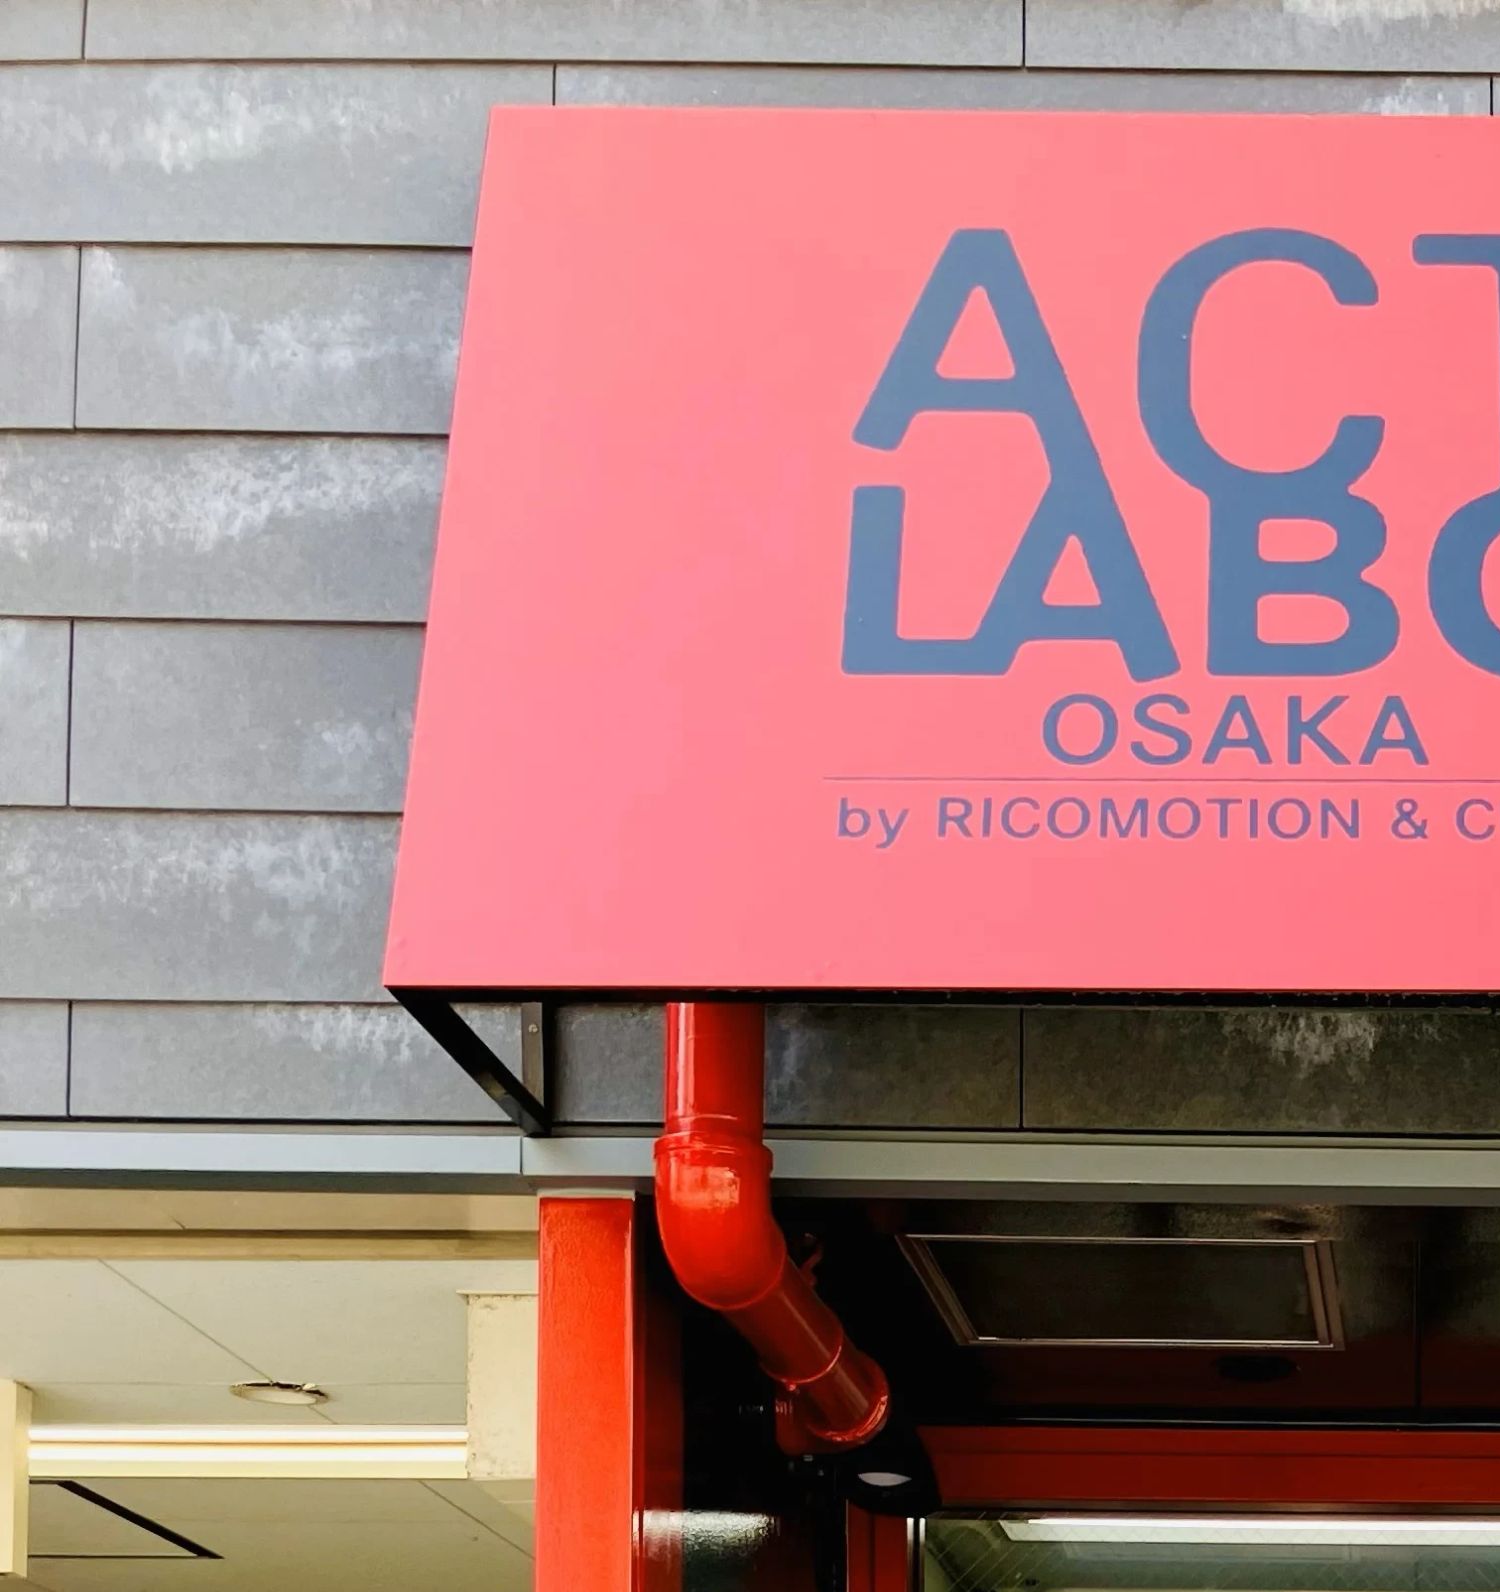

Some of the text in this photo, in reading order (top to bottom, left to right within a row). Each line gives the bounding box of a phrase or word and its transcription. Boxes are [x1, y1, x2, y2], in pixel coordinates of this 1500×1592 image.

[1042, 693, 1429, 766] OSAKA
[838, 798, 909, 849] by
[937, 797, 1360, 840] RICOMOTION
[1390, 798, 1429, 840] &
